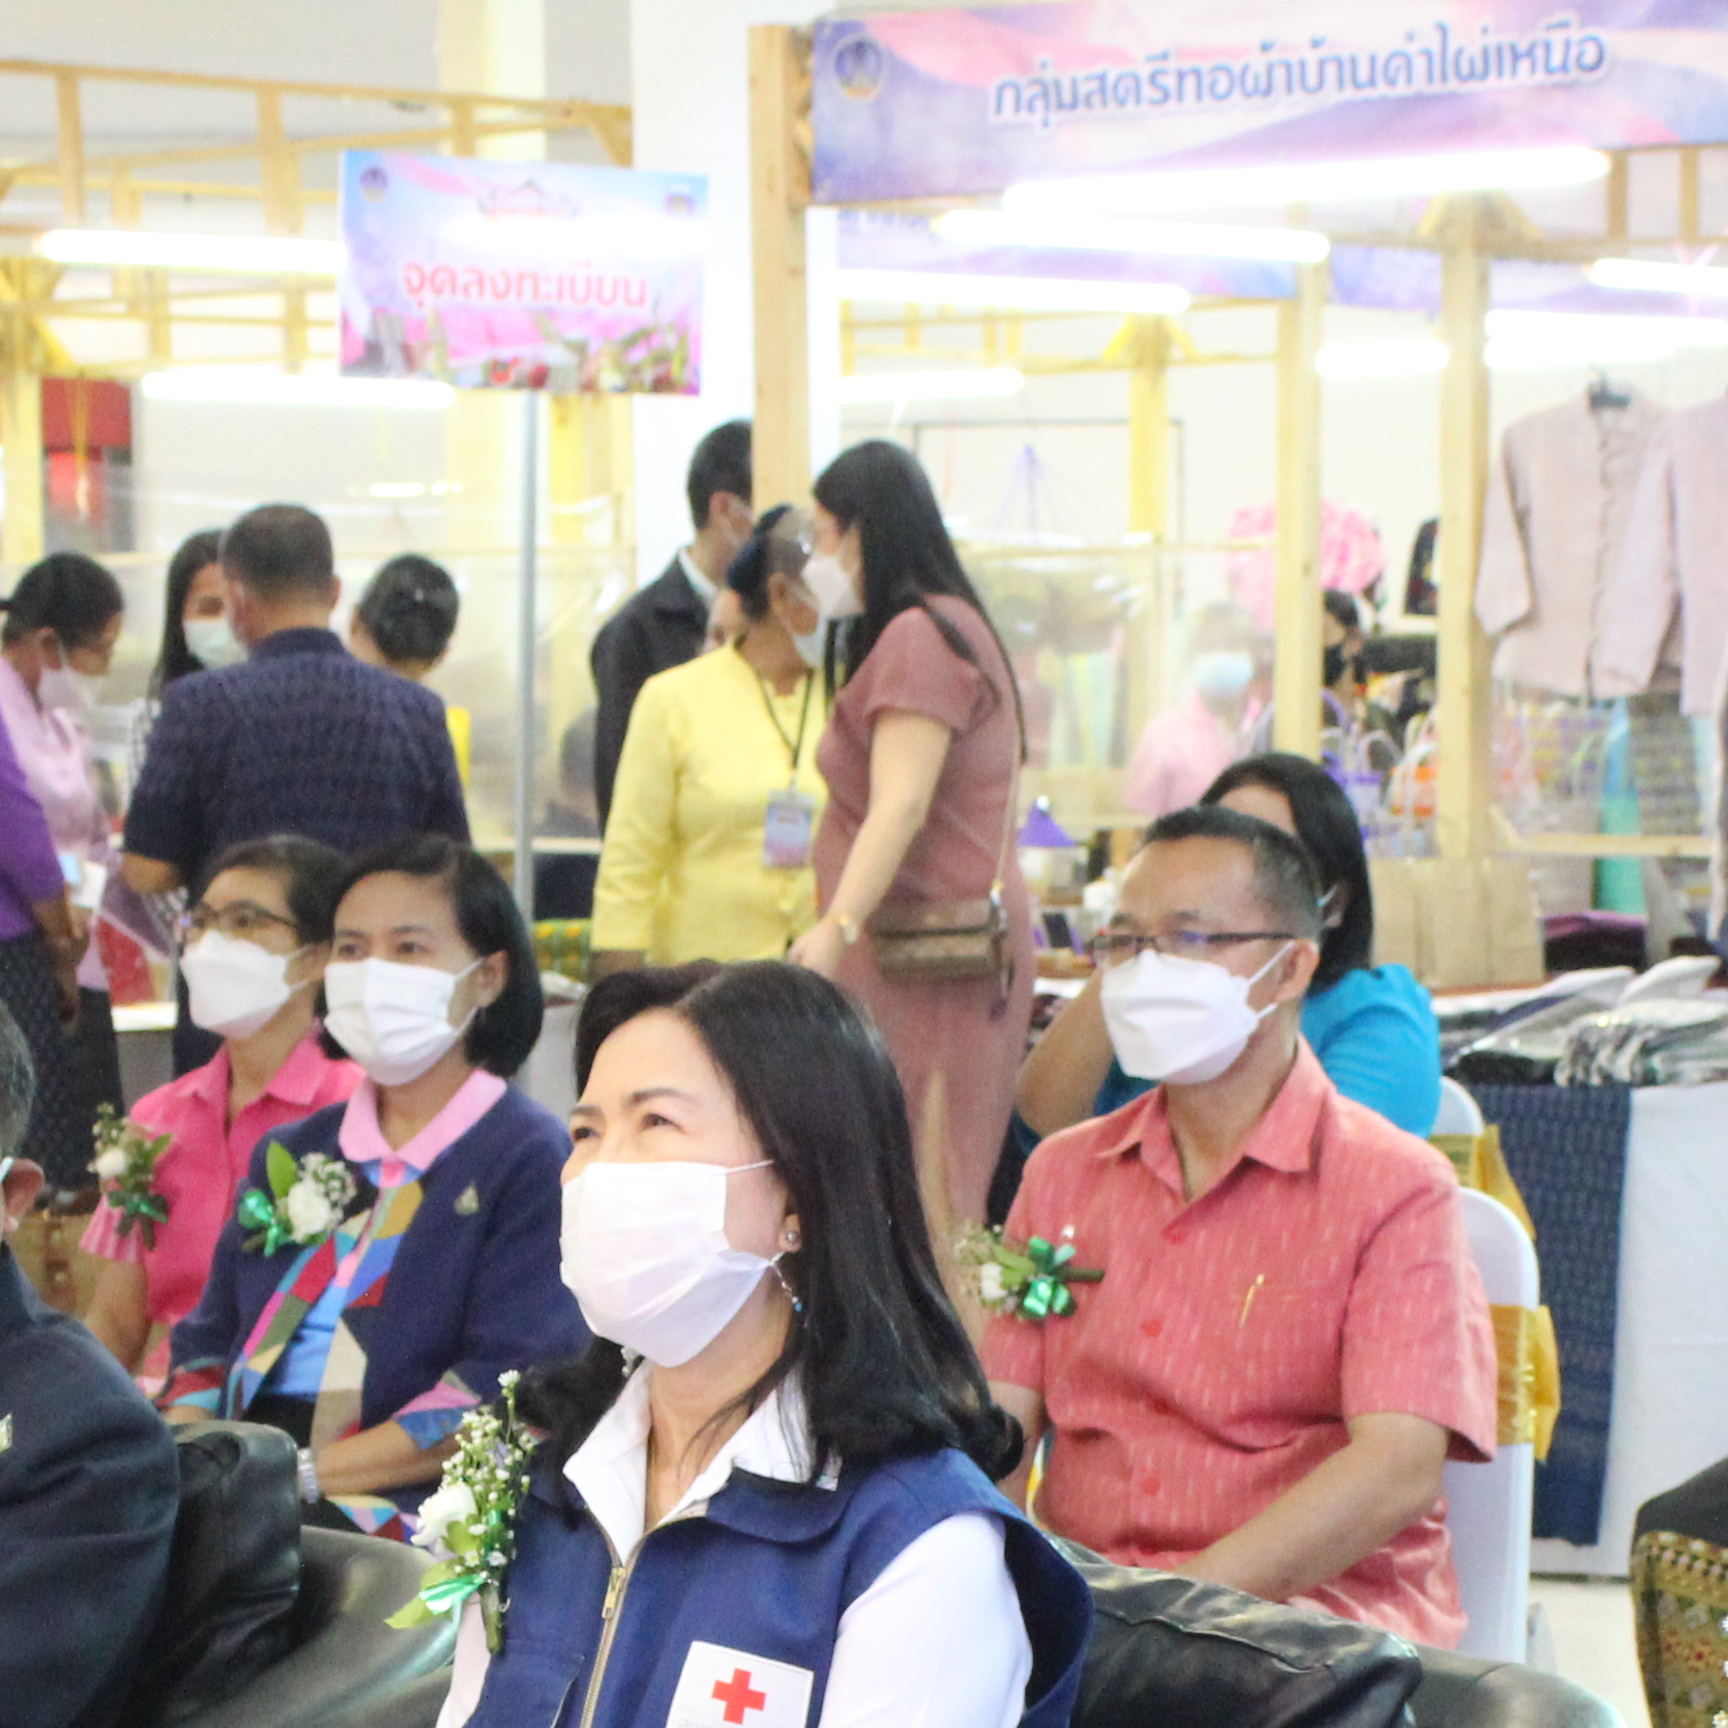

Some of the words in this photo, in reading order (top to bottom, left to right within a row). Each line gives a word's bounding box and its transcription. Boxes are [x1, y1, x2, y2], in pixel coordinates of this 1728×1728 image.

[402, 260, 650, 310] จุดลงทะเบียน
